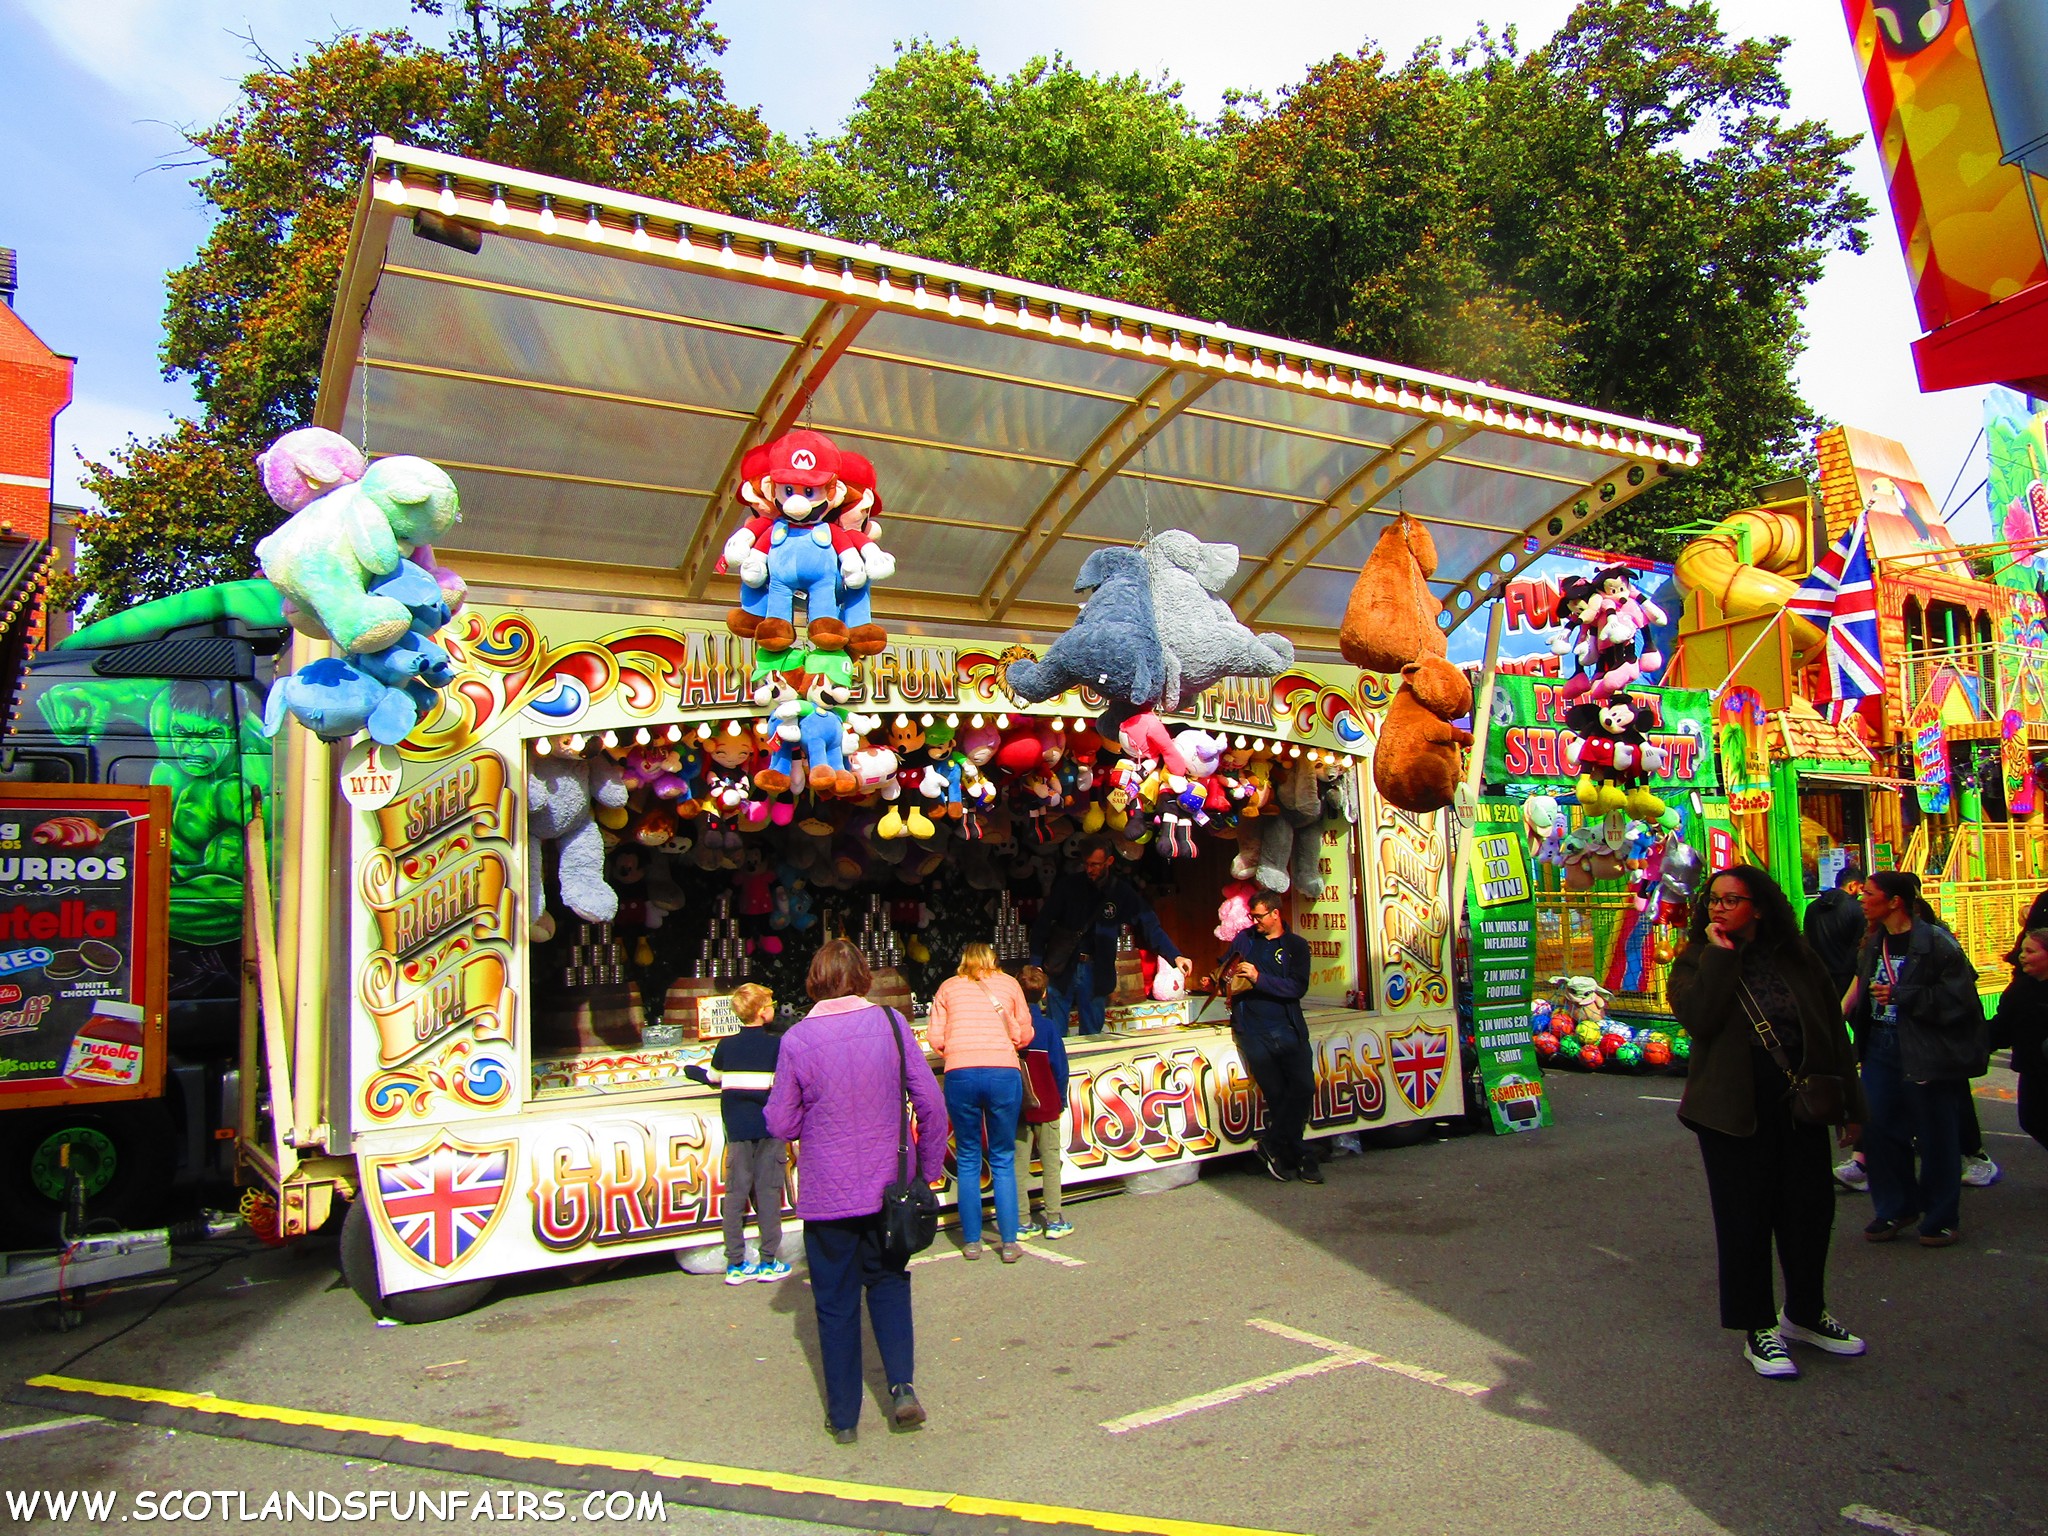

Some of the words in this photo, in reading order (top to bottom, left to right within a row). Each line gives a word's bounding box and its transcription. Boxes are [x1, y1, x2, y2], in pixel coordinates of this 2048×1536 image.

[793, 453, 813, 465] M
[872, 644, 959, 702] FUN
[1203, 676, 1276, 730] FAIR
[366, 746, 377, 773] 1
[1920, 741, 1942, 769] THE
[350, 775, 392, 795] WIN
[405, 761, 479, 841] STEP
[1457, 805, 1474, 818] WIN
[1474, 804, 1492, 822] IN
[1493, 804, 1519, 823] £20
[1478, 840, 1490, 859] 1
[1490, 838, 1509, 857] IN
[1395, 841, 1428, 898] YOUR
[1486, 858, 1510, 879] TO
[1480, 877, 1523, 900] WIN!
[396, 857, 483, 956] RIGHT
[1300, 913, 1320, 930] OFF
[1322, 913, 1347, 930] THE
[1485, 921, 1494, 933] IN
[1495, 920, 1517, 932] WINS
[1518, 920, 1529, 932] AN
[1484, 936, 1527, 949] INFLATABLE
[1483, 970, 1489, 982] 2
[1489, 970, 1498, 982] IN
[1499, 969, 1520, 981] WINS
[1520, 968, 1526, 979] A
[61, 988, 123, 998] CHOCOLATE
[75, 981, 110, 989] WHITE
[1486, 984, 1521, 998] FOOTBALL
[414, 967, 466, 1042] UP!
[712, 1007, 732, 1016] MUST
[715, 1025, 725, 1034] TO
[1478, 1019, 1485, 1032] 3
[1485, 1018, 1493, 1031] IN
[1494, 1017, 1513, 1029] WINS
[1514, 1015, 1528, 1027] £20
[1480, 1035, 1491, 1048] OR
[1491, 1035, 1497, 1047] A
[1497, 1031, 1531, 1046] FOOTBALL
[81, 1042, 139, 1060] nutella
[1493, 1048, 1522, 1063] T-SHIRT
[9, 1058, 57, 1072] Sauce
[1490, 1088, 1498, 1102] 3
[1498, 1084, 1525, 1101] SHOTS
[1525, 1081, 1543, 1096] FOR
